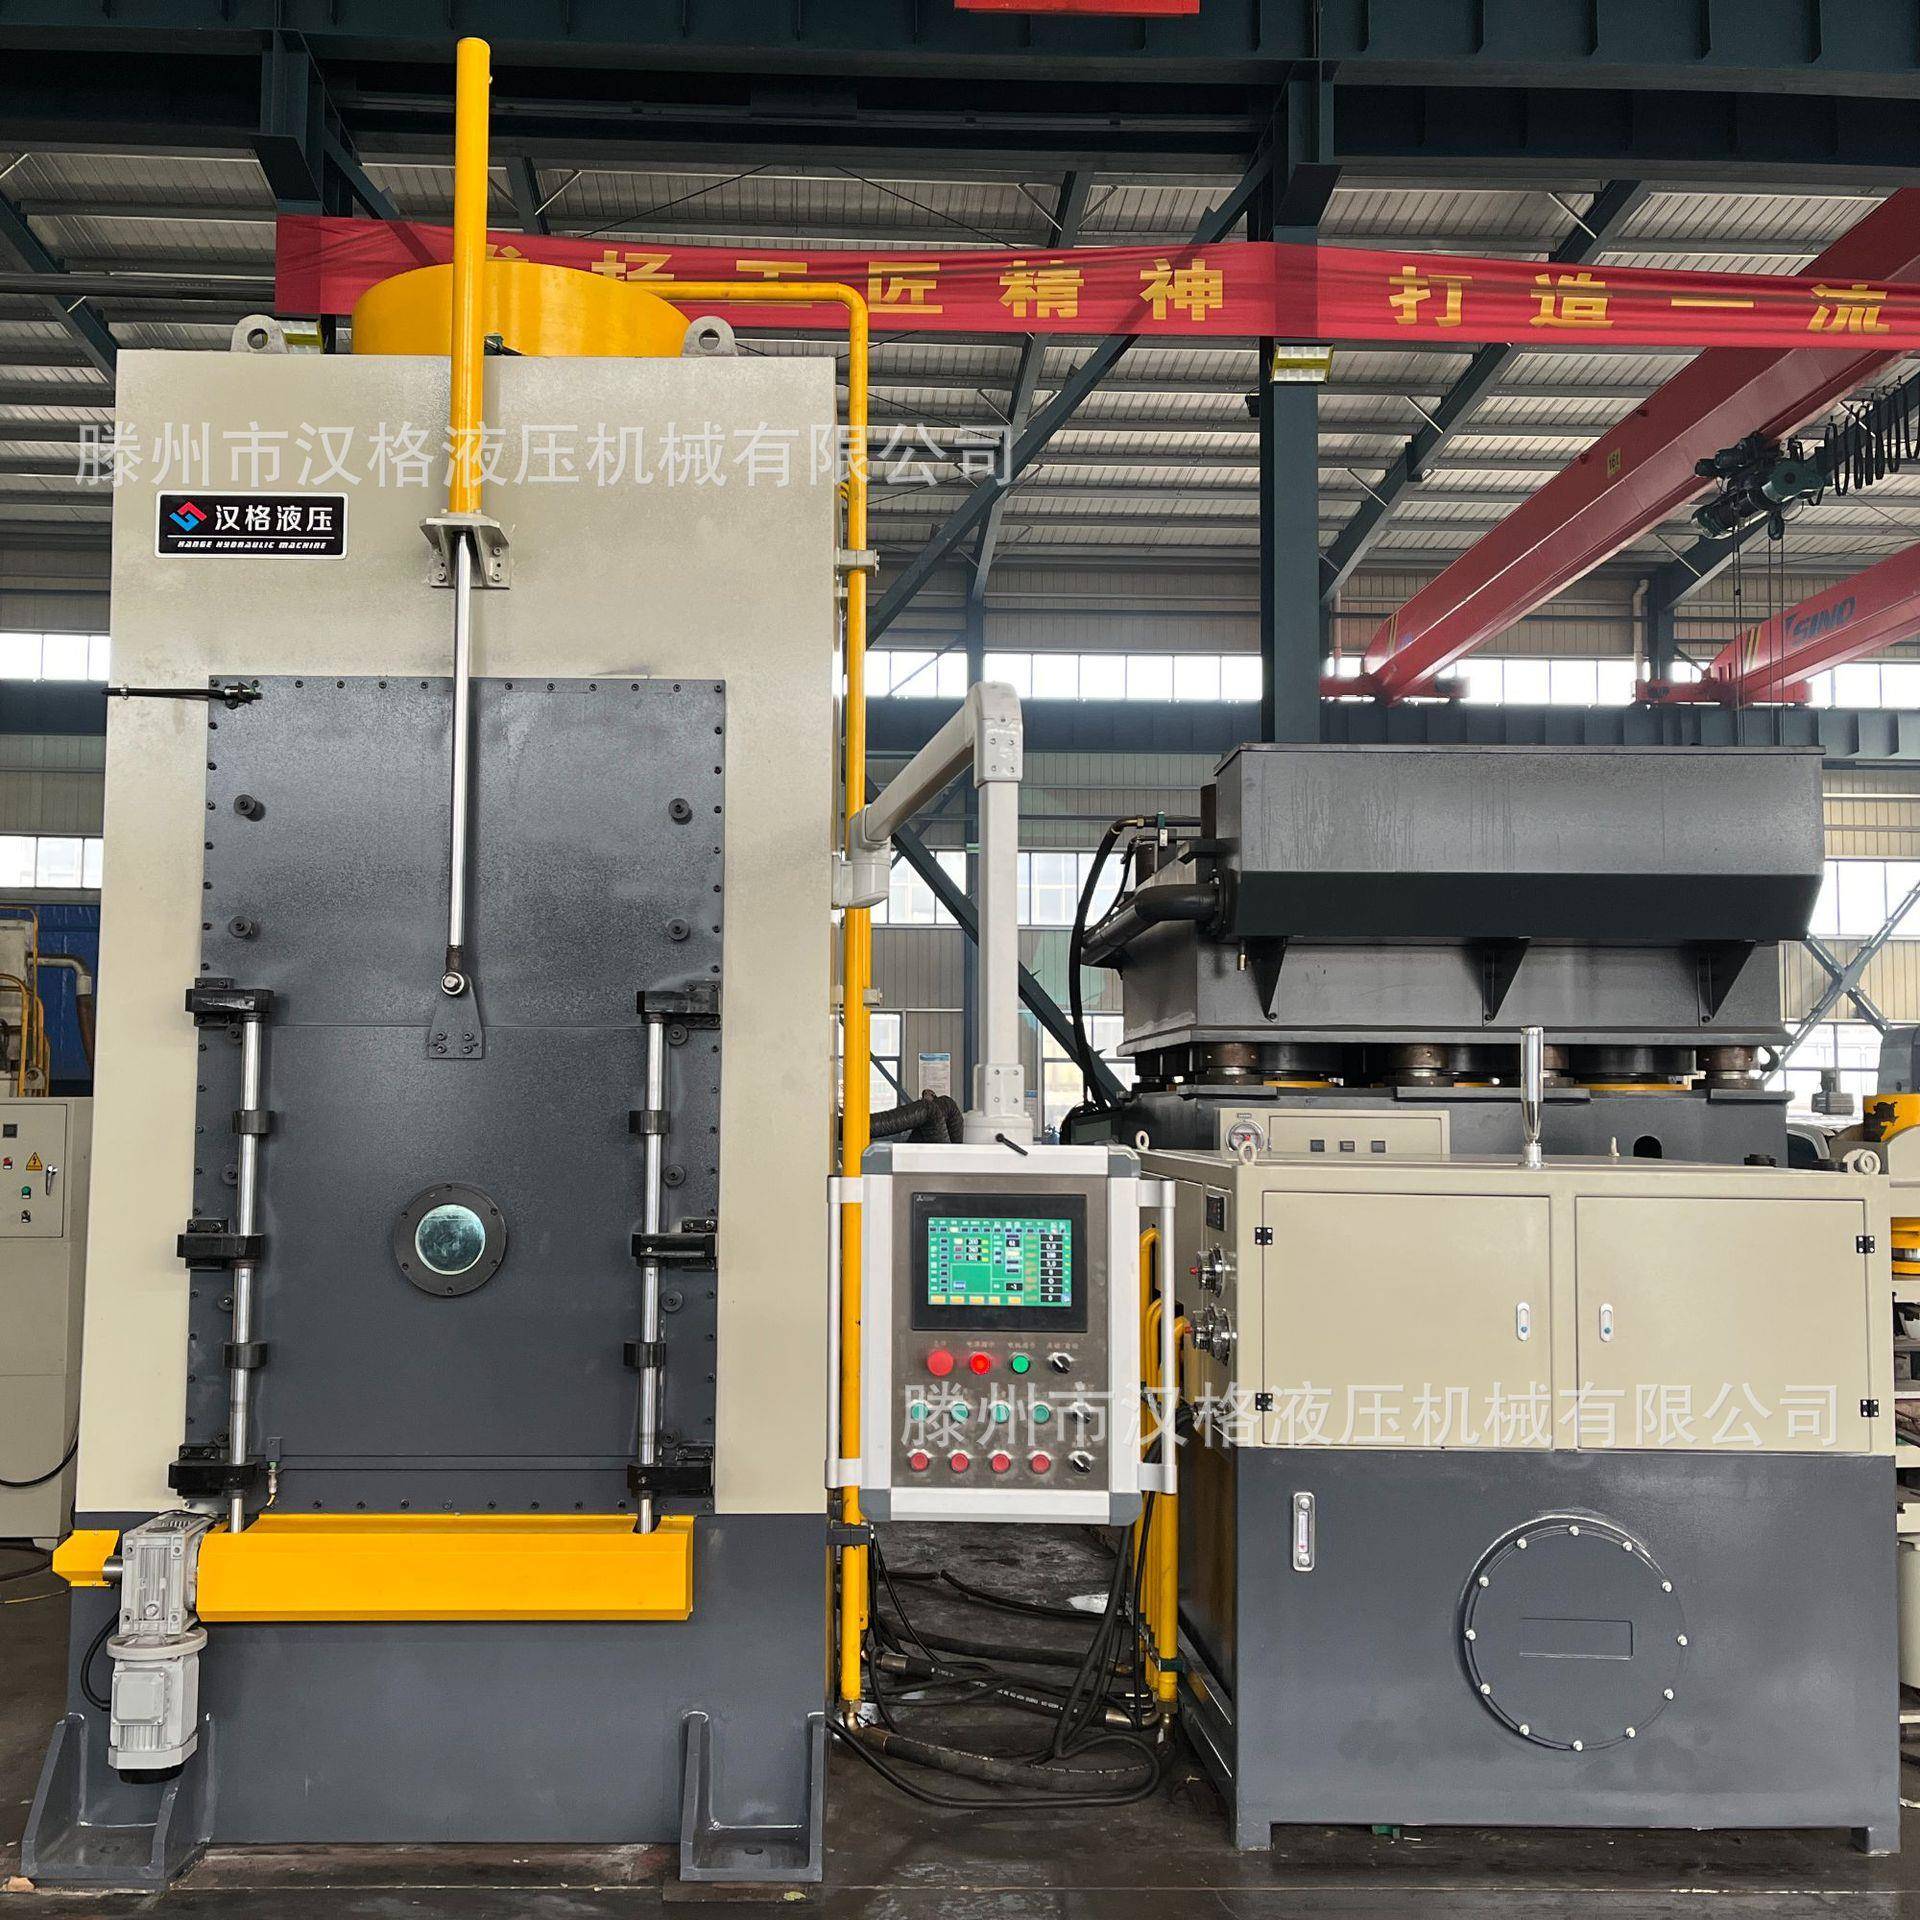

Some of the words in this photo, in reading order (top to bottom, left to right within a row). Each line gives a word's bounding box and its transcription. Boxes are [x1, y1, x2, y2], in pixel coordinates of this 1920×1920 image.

[1389, 266, 1890, 333] 打造一流
[214, 504, 333, 532] 汉格液压
[177, 540, 212, 549] HANGE
[215, 540, 275, 549] HYDRAULIC
[278, 541, 327, 549] MACHINE
